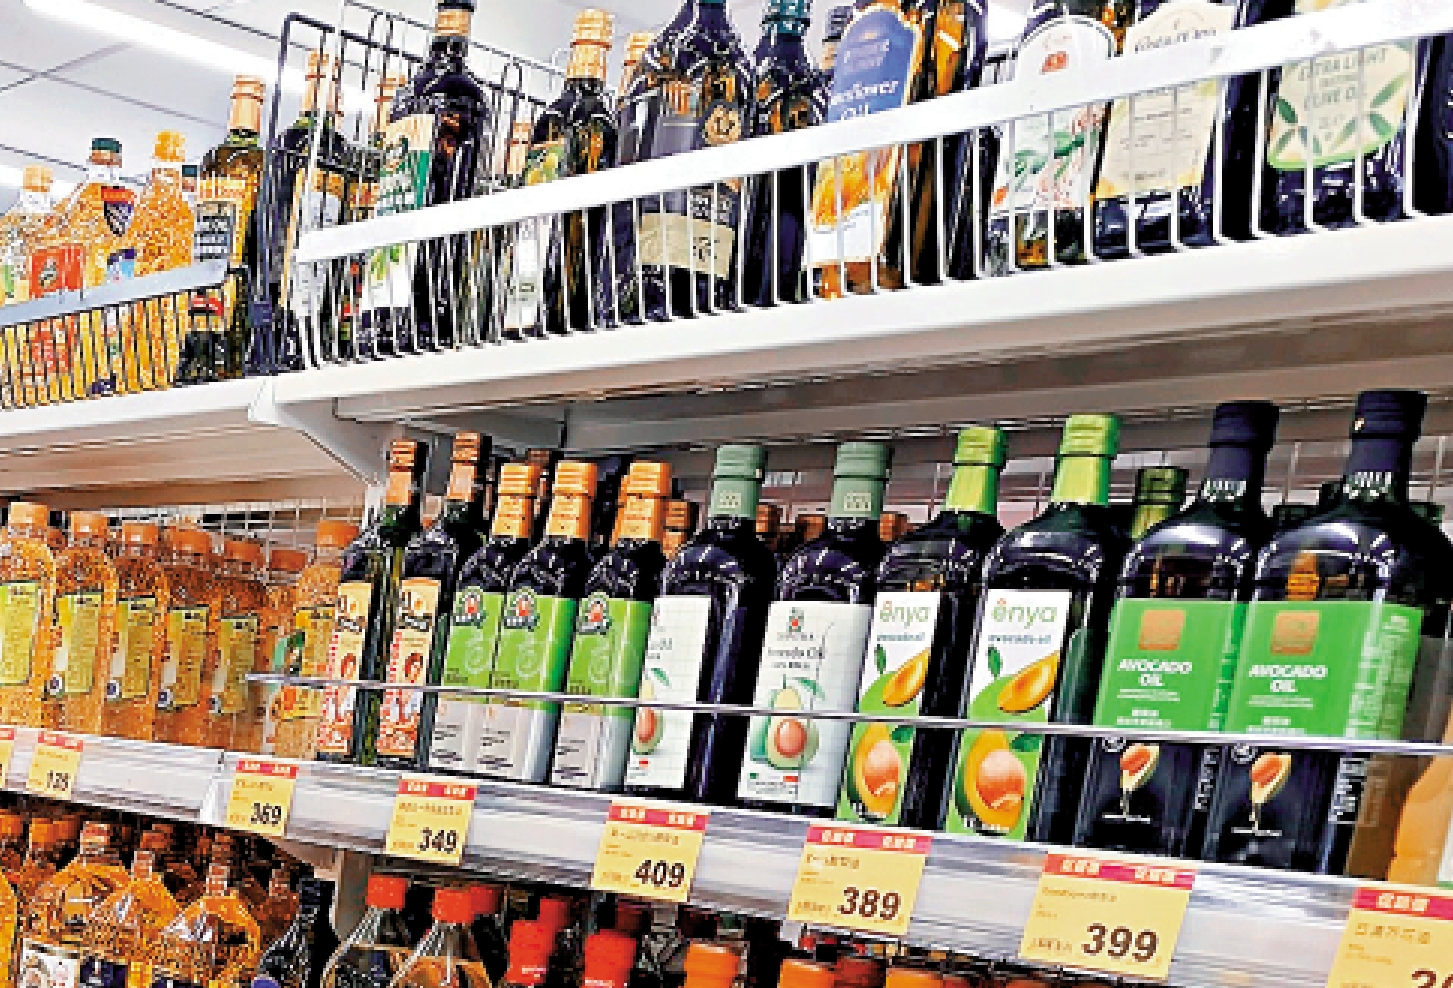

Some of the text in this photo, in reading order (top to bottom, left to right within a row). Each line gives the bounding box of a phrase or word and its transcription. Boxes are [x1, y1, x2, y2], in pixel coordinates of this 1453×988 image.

[1117, 658, 1193, 674] AVOCADO
[1248, 664, 1328, 680] AVOCADO
[1138, 674, 1164, 688] OIL
[1269, 680, 1297, 693] OIL
[249, 801, 282, 826] 369
[418, 828, 459, 854] 349
[634, 859, 685, 889] 409
[838, 887, 902, 921] 389
[1081, 922, 1159, 963] 399
